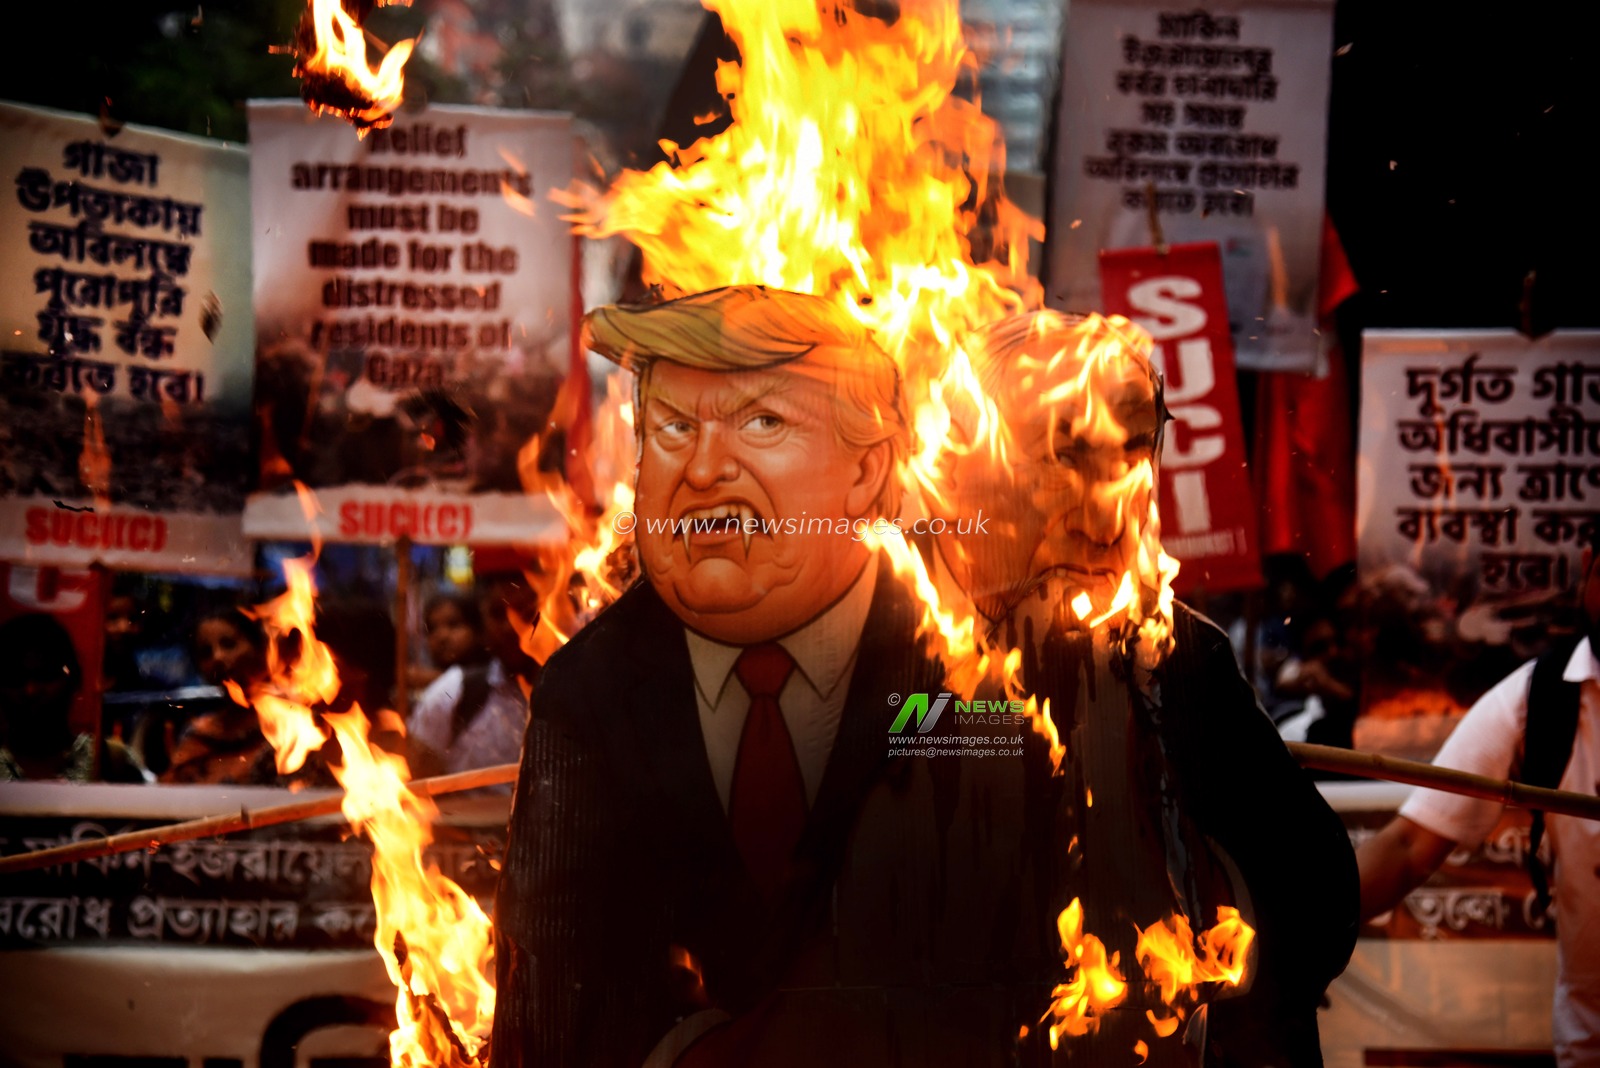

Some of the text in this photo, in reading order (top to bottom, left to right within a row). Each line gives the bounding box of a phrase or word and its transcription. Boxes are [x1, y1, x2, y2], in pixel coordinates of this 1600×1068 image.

[63, 139, 160, 187] গাজা
[347, 202, 480, 233] must be
[308, 239, 518, 274] made for the
[321, 277, 501, 310] distressed
[310, 316, 512, 350] residents of
[1126, 275, 1226, 533] SUCI
[1405, 353, 1518, 417] দুর্গত
[1408, 464, 1504, 499] জন্য
[25, 505, 169, 553] SUCI(C)
[339, 499, 473, 539] SUCI(C)
[1396, 506, 1519, 547] ব্যবস্থা
[128, 895, 299, 943] প্রত্যাহার
